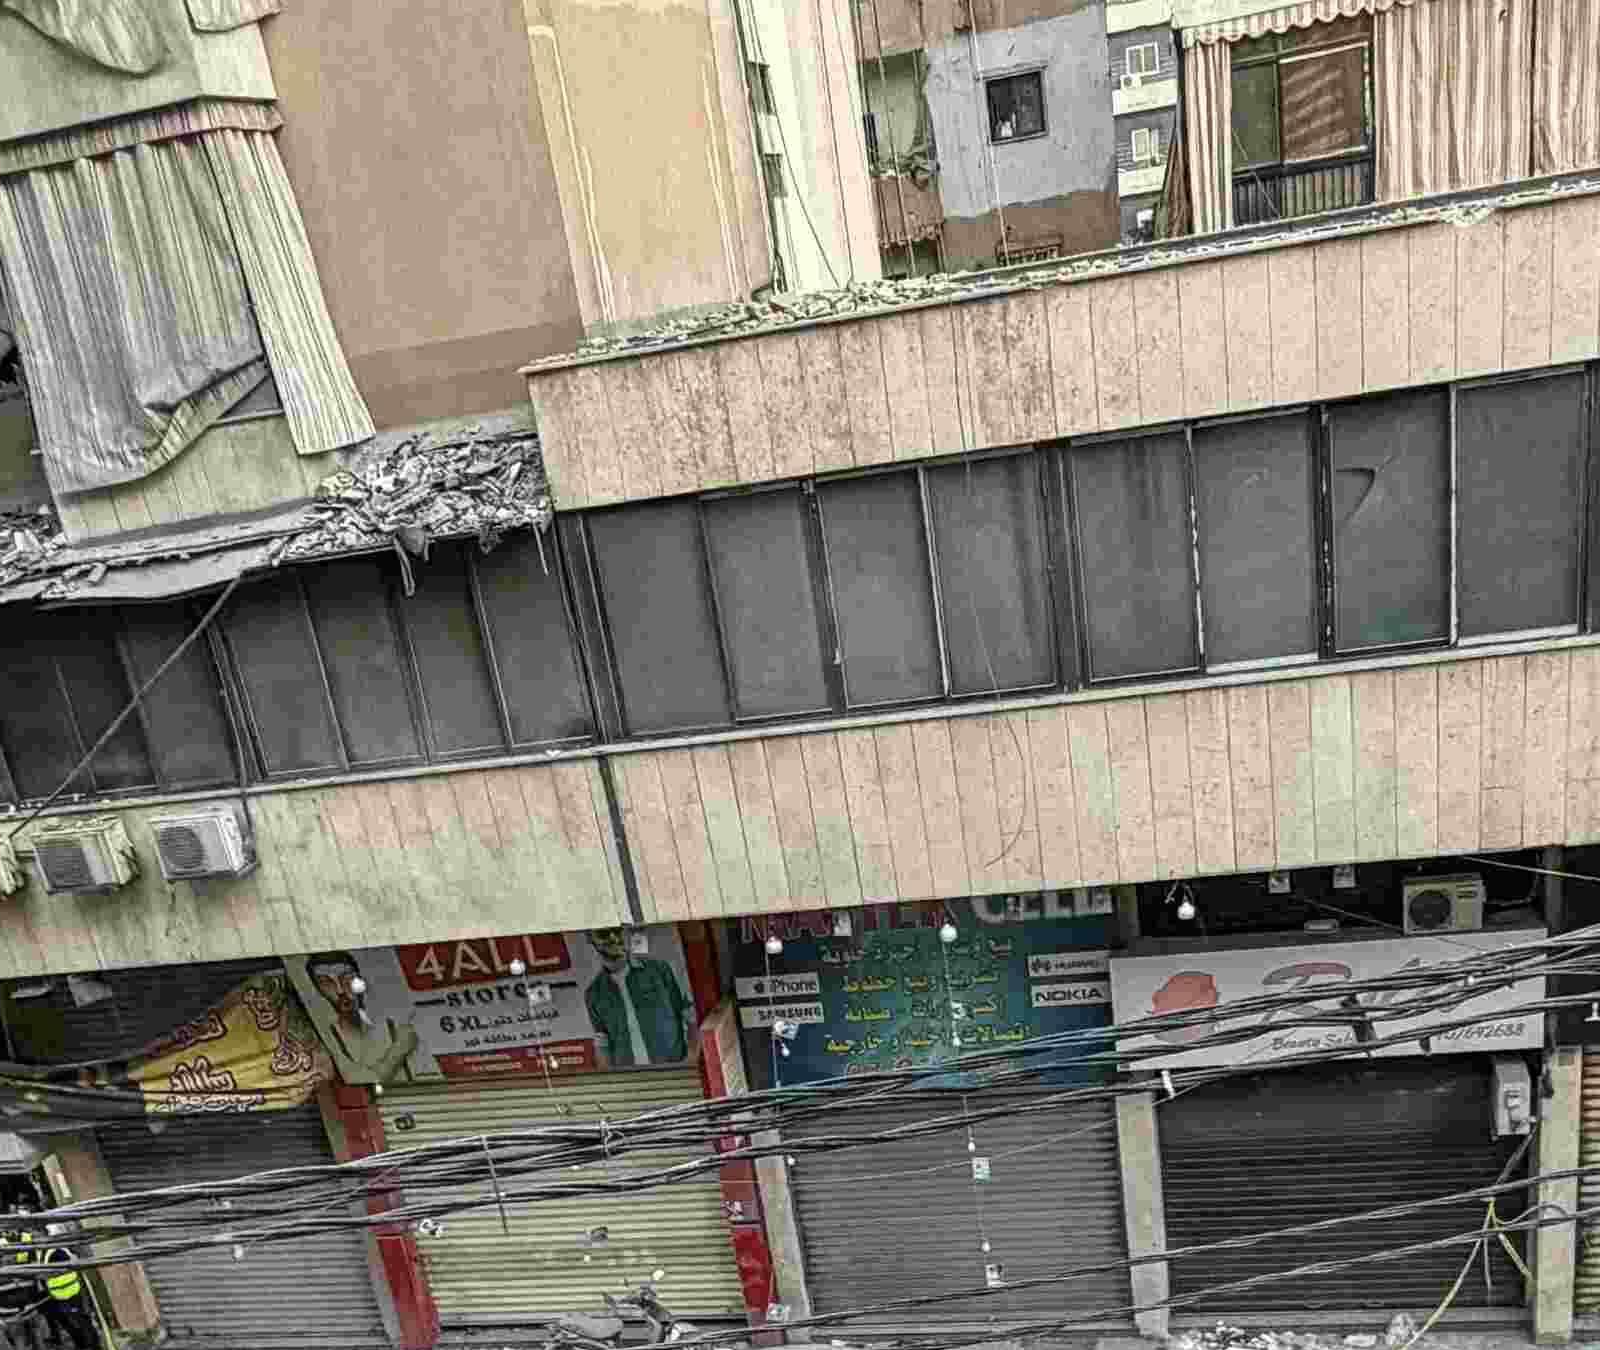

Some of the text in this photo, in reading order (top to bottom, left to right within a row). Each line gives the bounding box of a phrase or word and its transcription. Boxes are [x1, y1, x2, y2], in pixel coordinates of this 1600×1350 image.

[414, 933, 561, 982] 4ALL
[1034, 988, 1105, 1002] NOKIA
[757, 1006, 822, 1020] SAMSUNG
